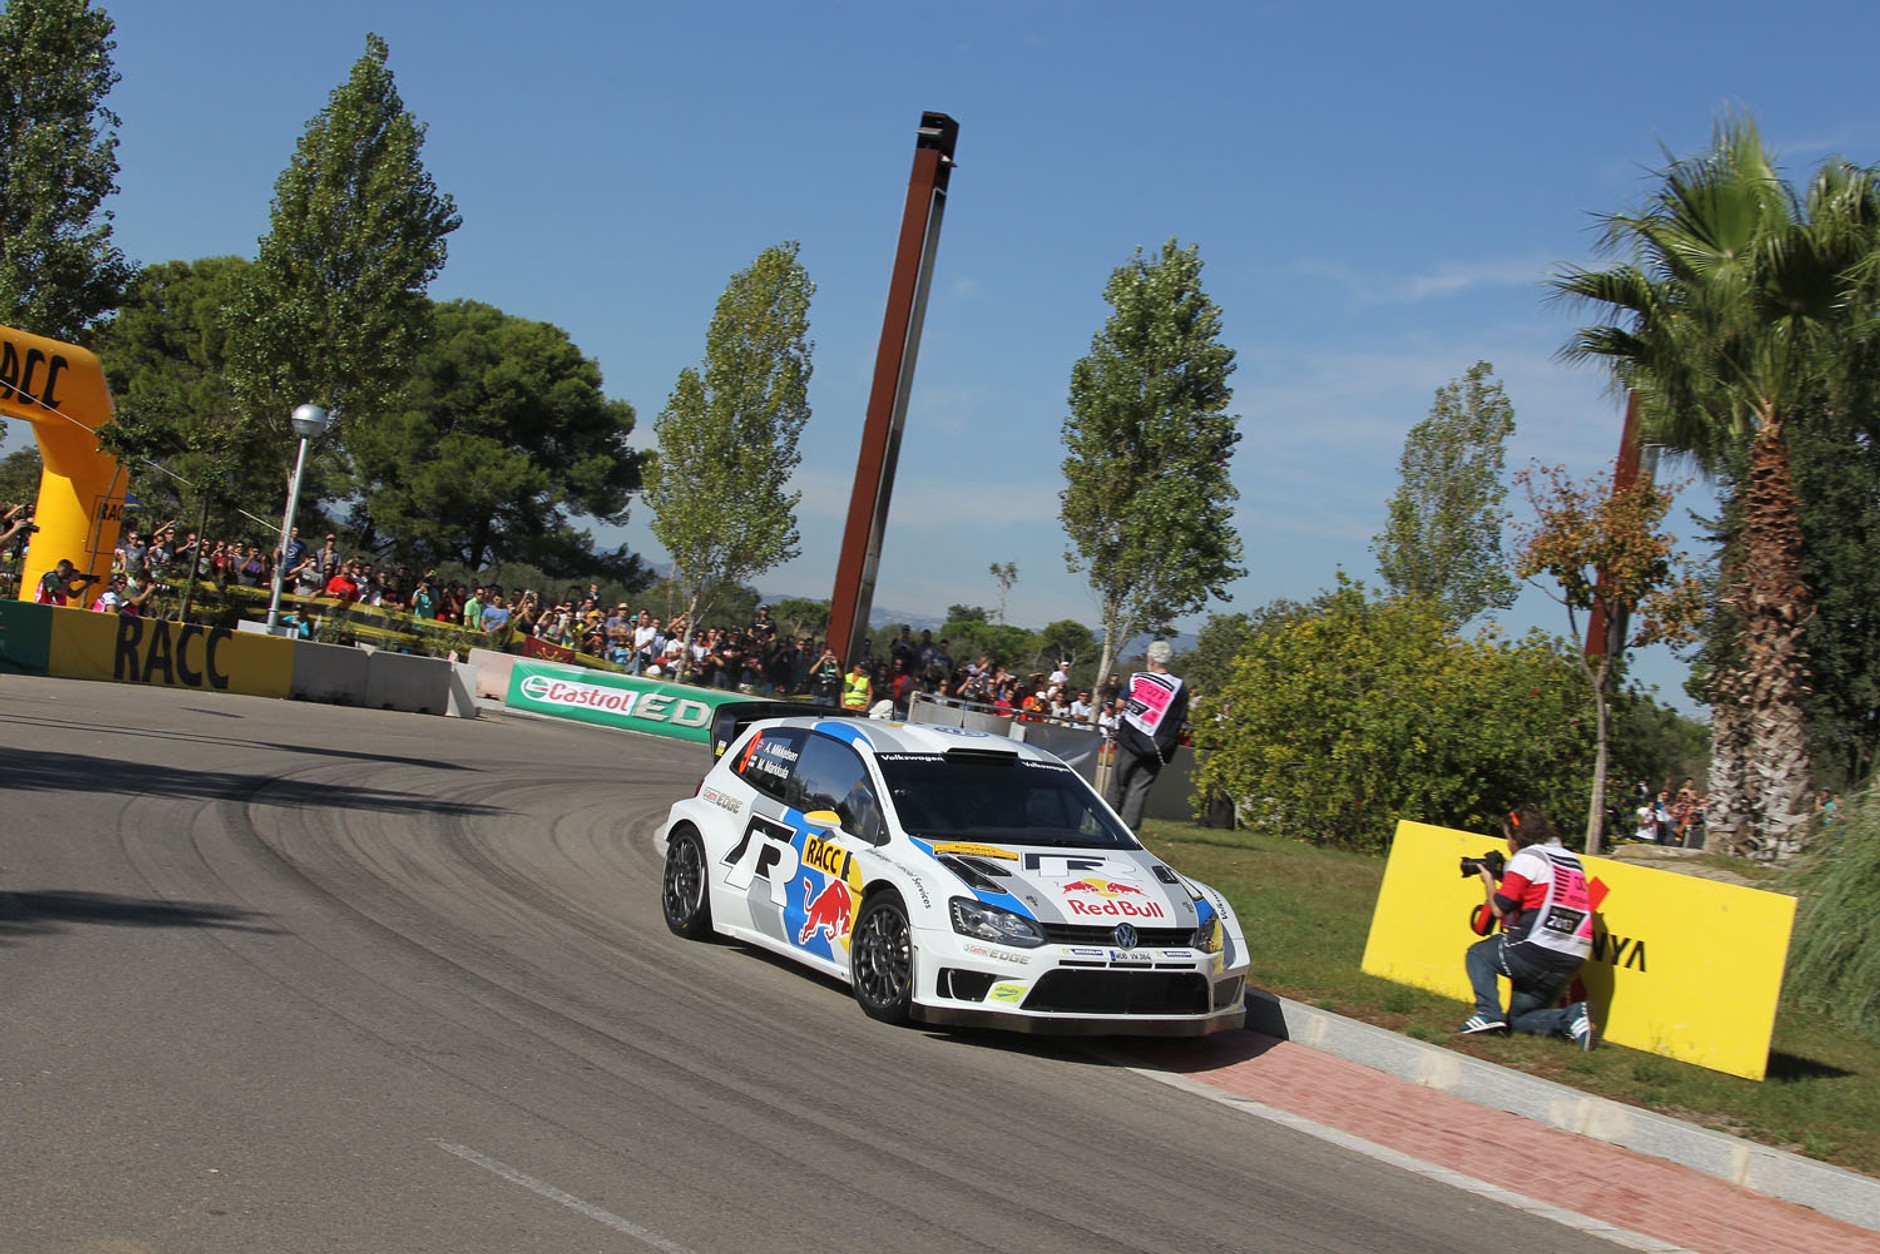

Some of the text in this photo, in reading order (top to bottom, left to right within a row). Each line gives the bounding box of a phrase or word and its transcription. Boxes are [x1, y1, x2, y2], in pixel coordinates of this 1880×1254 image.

[0, 341, 70, 410] ACC
[113, 612, 232, 689] RACC
[548, 682, 716, 730] Castrol ED
[738, 730, 763, 774] 9
[881, 754, 944, 762] Volkswagen
[806, 838, 842, 874] RACC
[911, 876, 932, 910] Services
[1068, 899, 1165, 919] Red Bull
[989, 949, 1032, 965] EDGE
[1594, 932, 1645, 973] NYA
